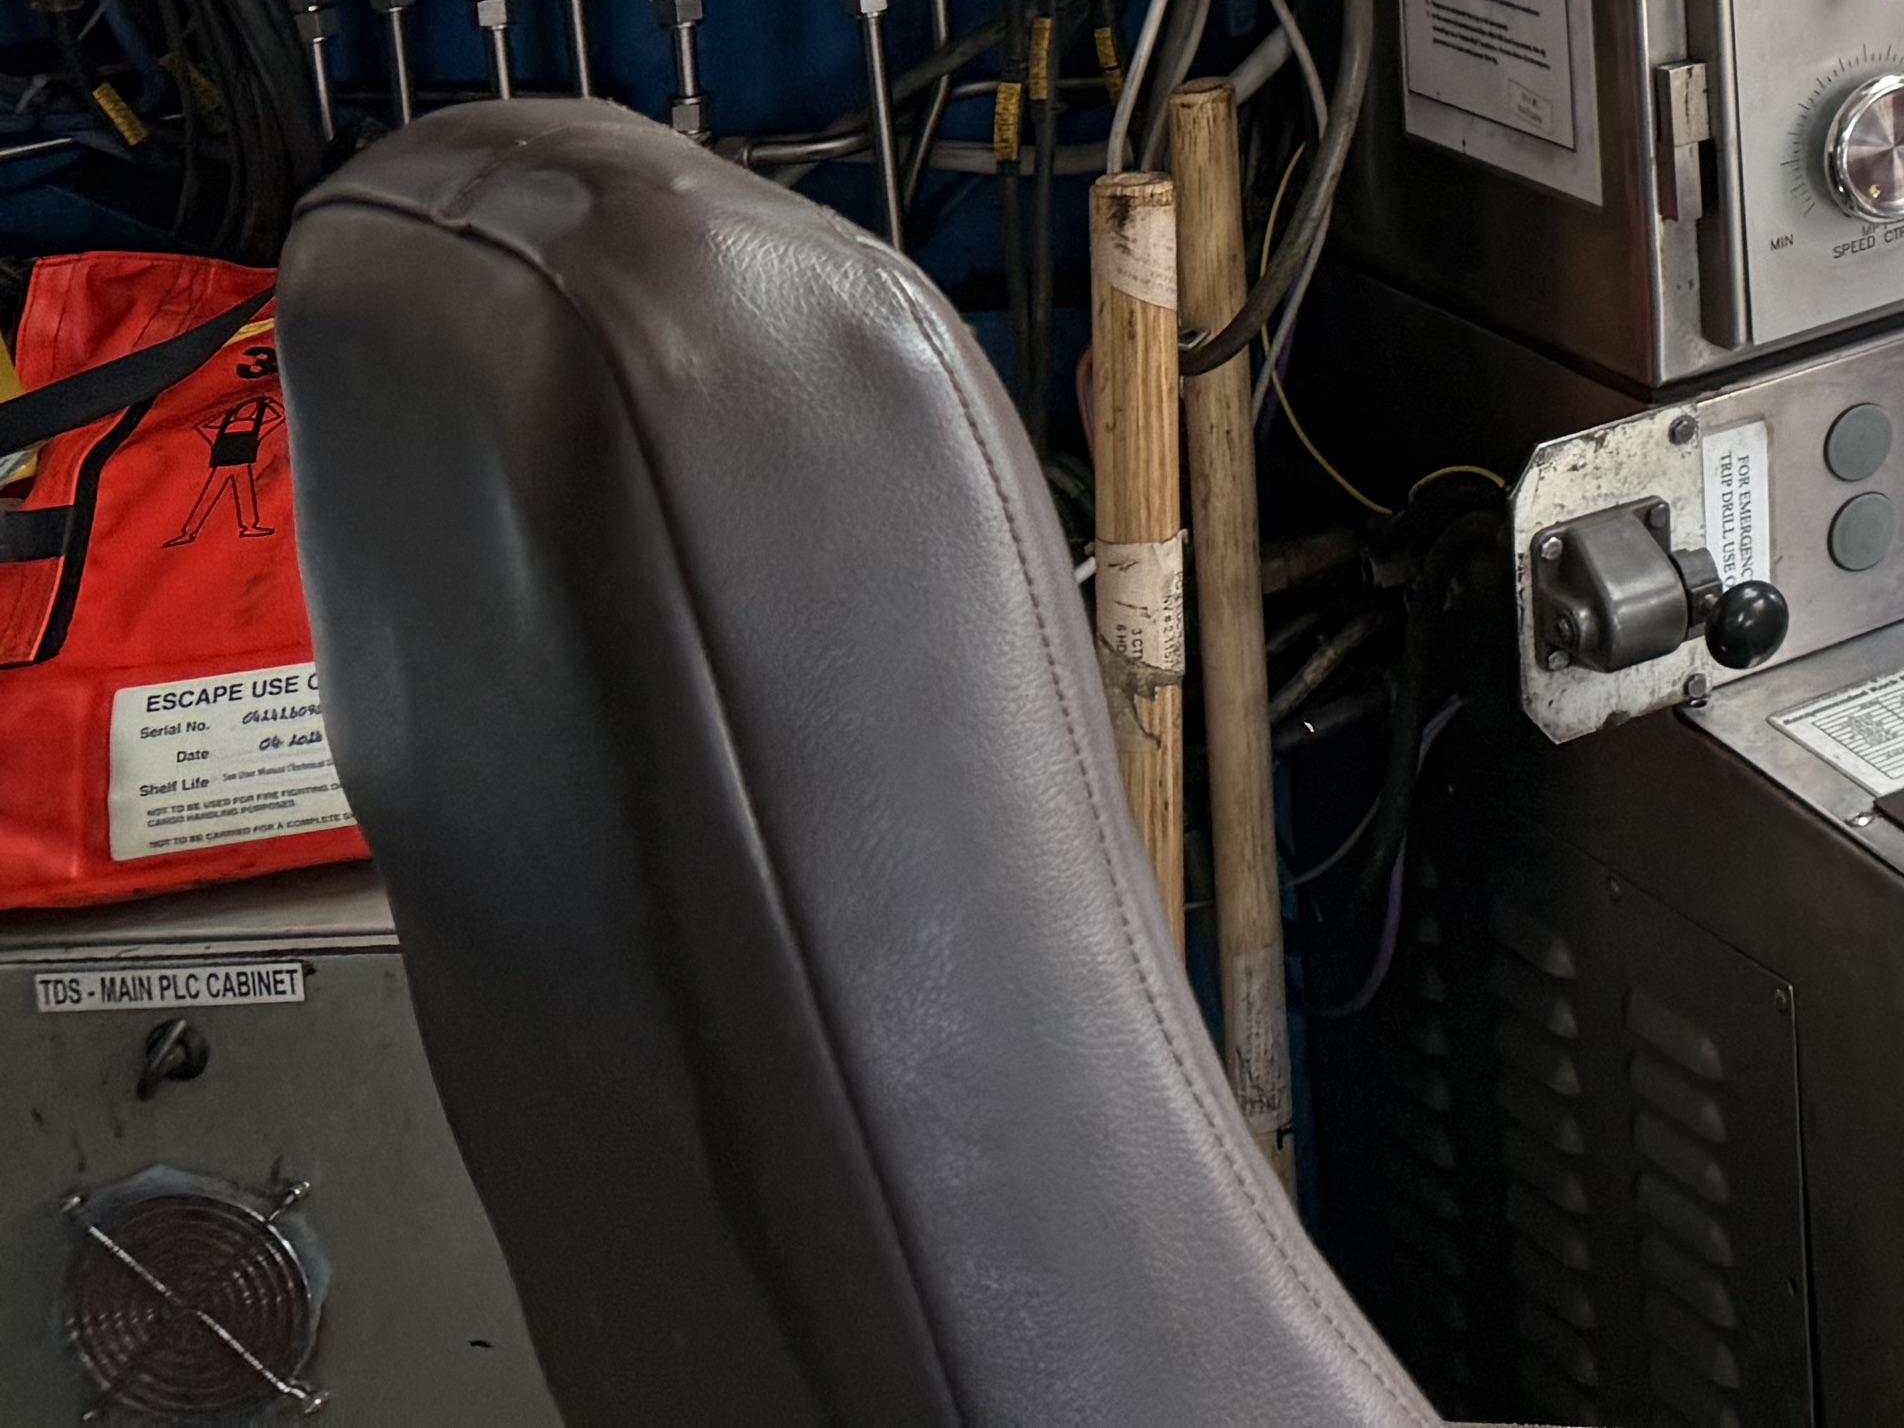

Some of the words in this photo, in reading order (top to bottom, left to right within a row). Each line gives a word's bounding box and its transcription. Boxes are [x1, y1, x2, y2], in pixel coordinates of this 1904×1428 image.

[1770, 234, 1794, 251] MIN
[1834, 236, 1875, 259] SPEED
[1720, 451, 1732, 487] TRIP
[1737, 455, 1750, 488] FOR
[1722, 491, 1735, 539] DRILL
[1723, 542, 1736, 573] USE
[146, 683, 243, 713] ESCAPE
[252, 675, 299, 699] USE
[140, 723, 181, 740] Serial
[186, 720, 211, 732] No.
[177, 750, 210, 763] Date
[140, 781, 177, 797] Shelf
[182, 777, 210, 791] Life
[39, 979, 81, 1005] TDS
[100, 976, 153, 1004] MAIN
[159, 973, 200, 1001] PLC
[206, 969, 298, 998] CABINET
